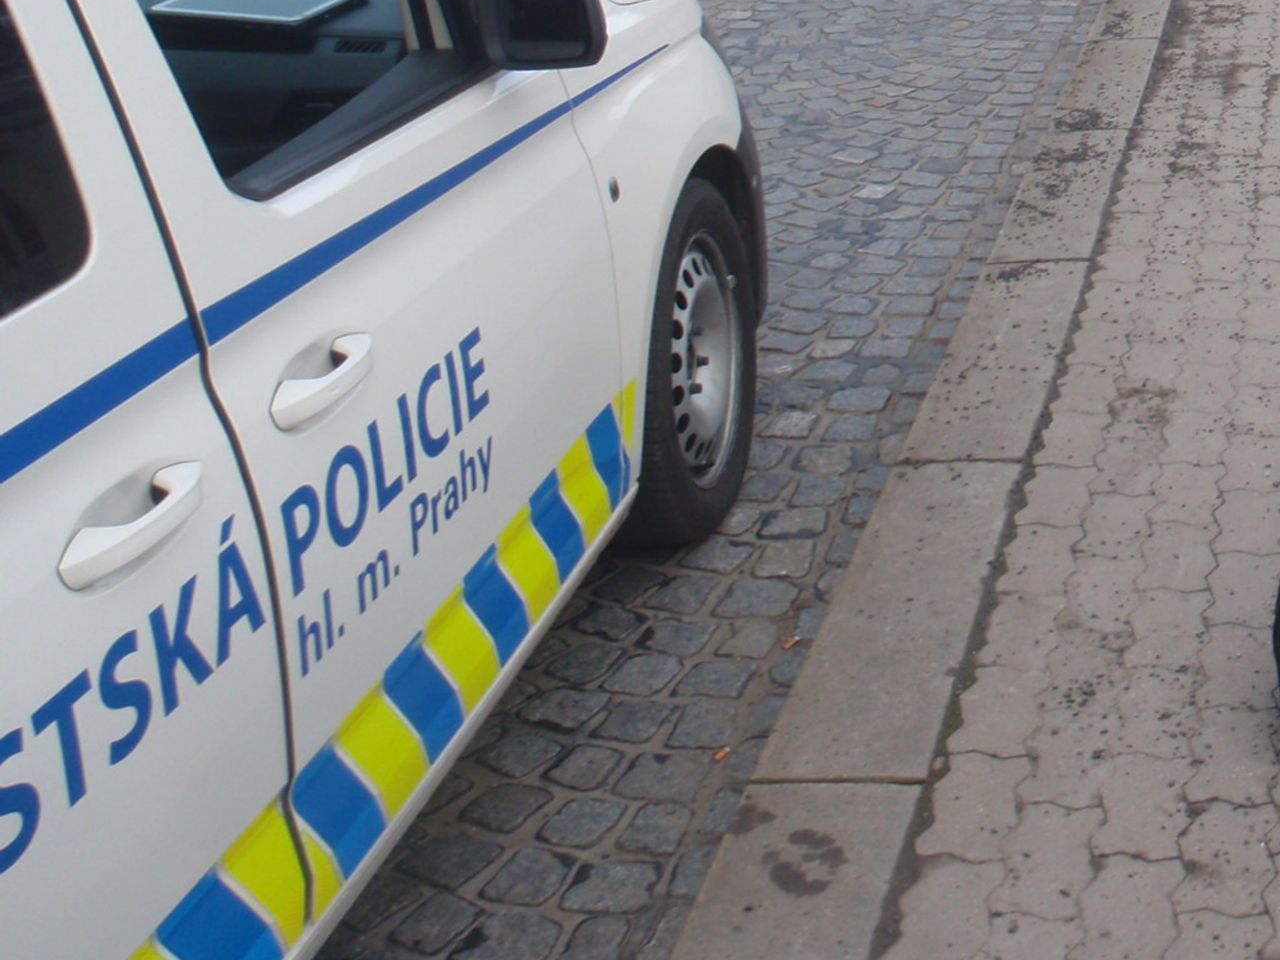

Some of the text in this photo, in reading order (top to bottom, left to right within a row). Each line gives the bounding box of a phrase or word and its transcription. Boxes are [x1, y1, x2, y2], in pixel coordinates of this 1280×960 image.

[281, 326, 490, 598] POLICIE
[297, 435, 493, 678] hl. m. Prahy
